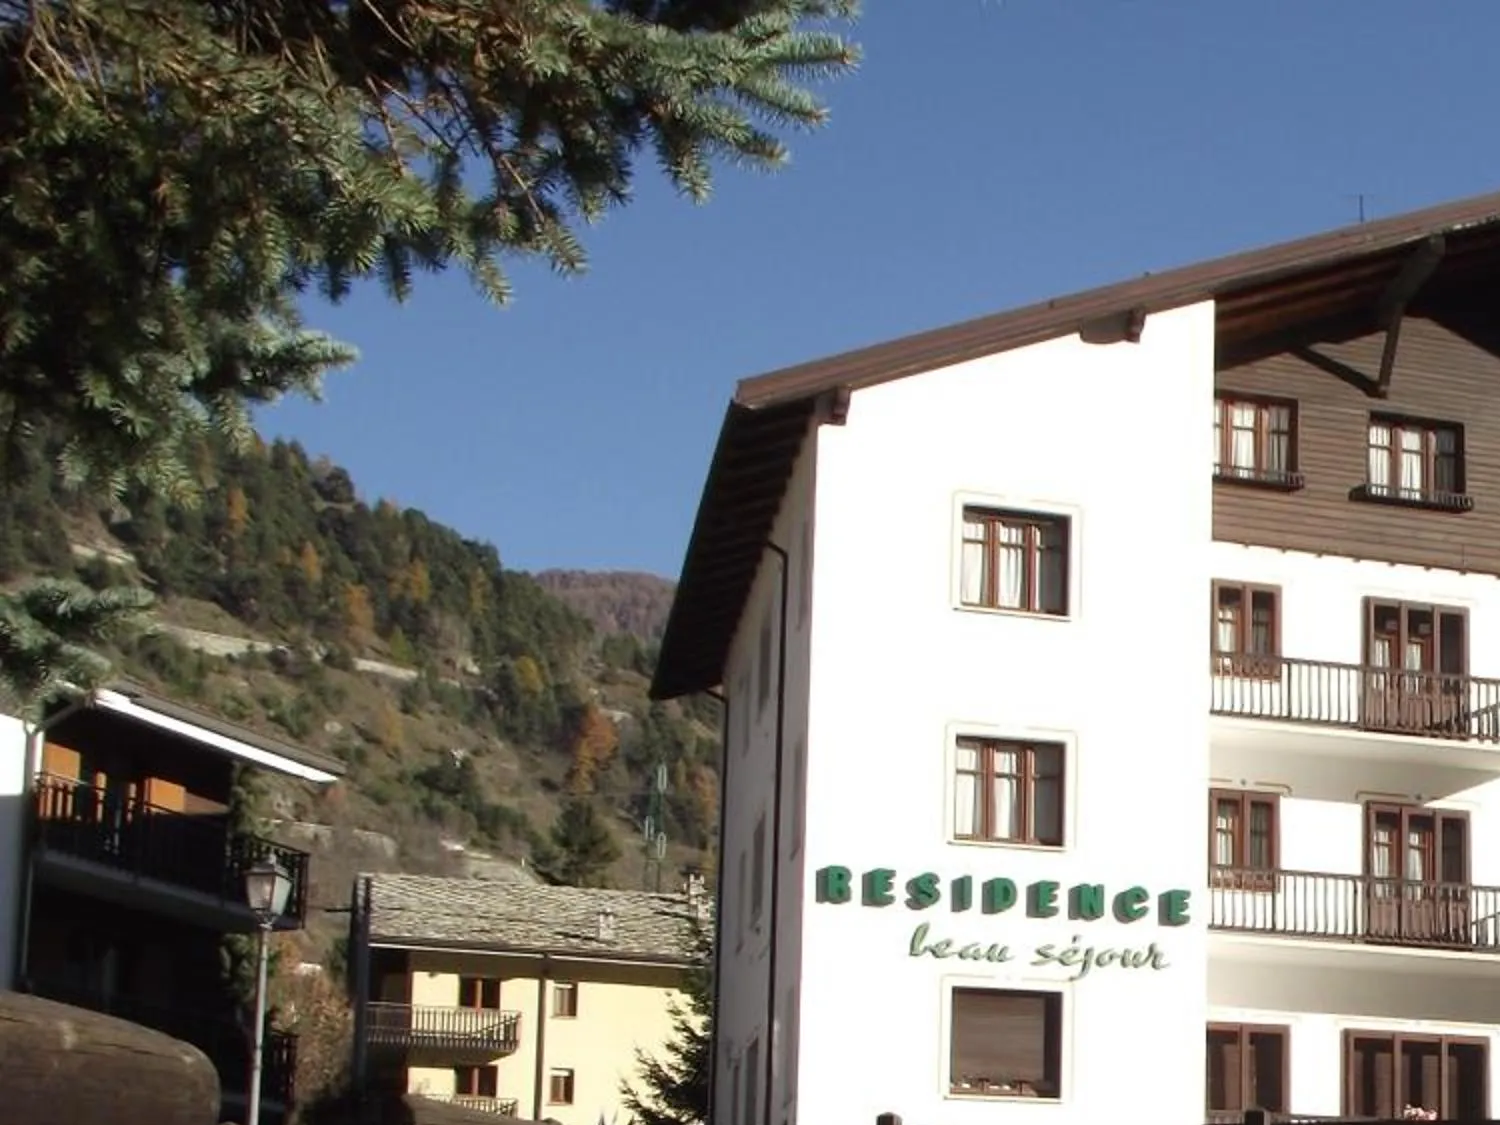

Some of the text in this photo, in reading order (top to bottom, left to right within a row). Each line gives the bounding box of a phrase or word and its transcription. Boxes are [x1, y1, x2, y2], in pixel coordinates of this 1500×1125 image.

[815, 865, 1191, 926] RESIDENCE
[909, 922, 1170, 981] beau séjour
